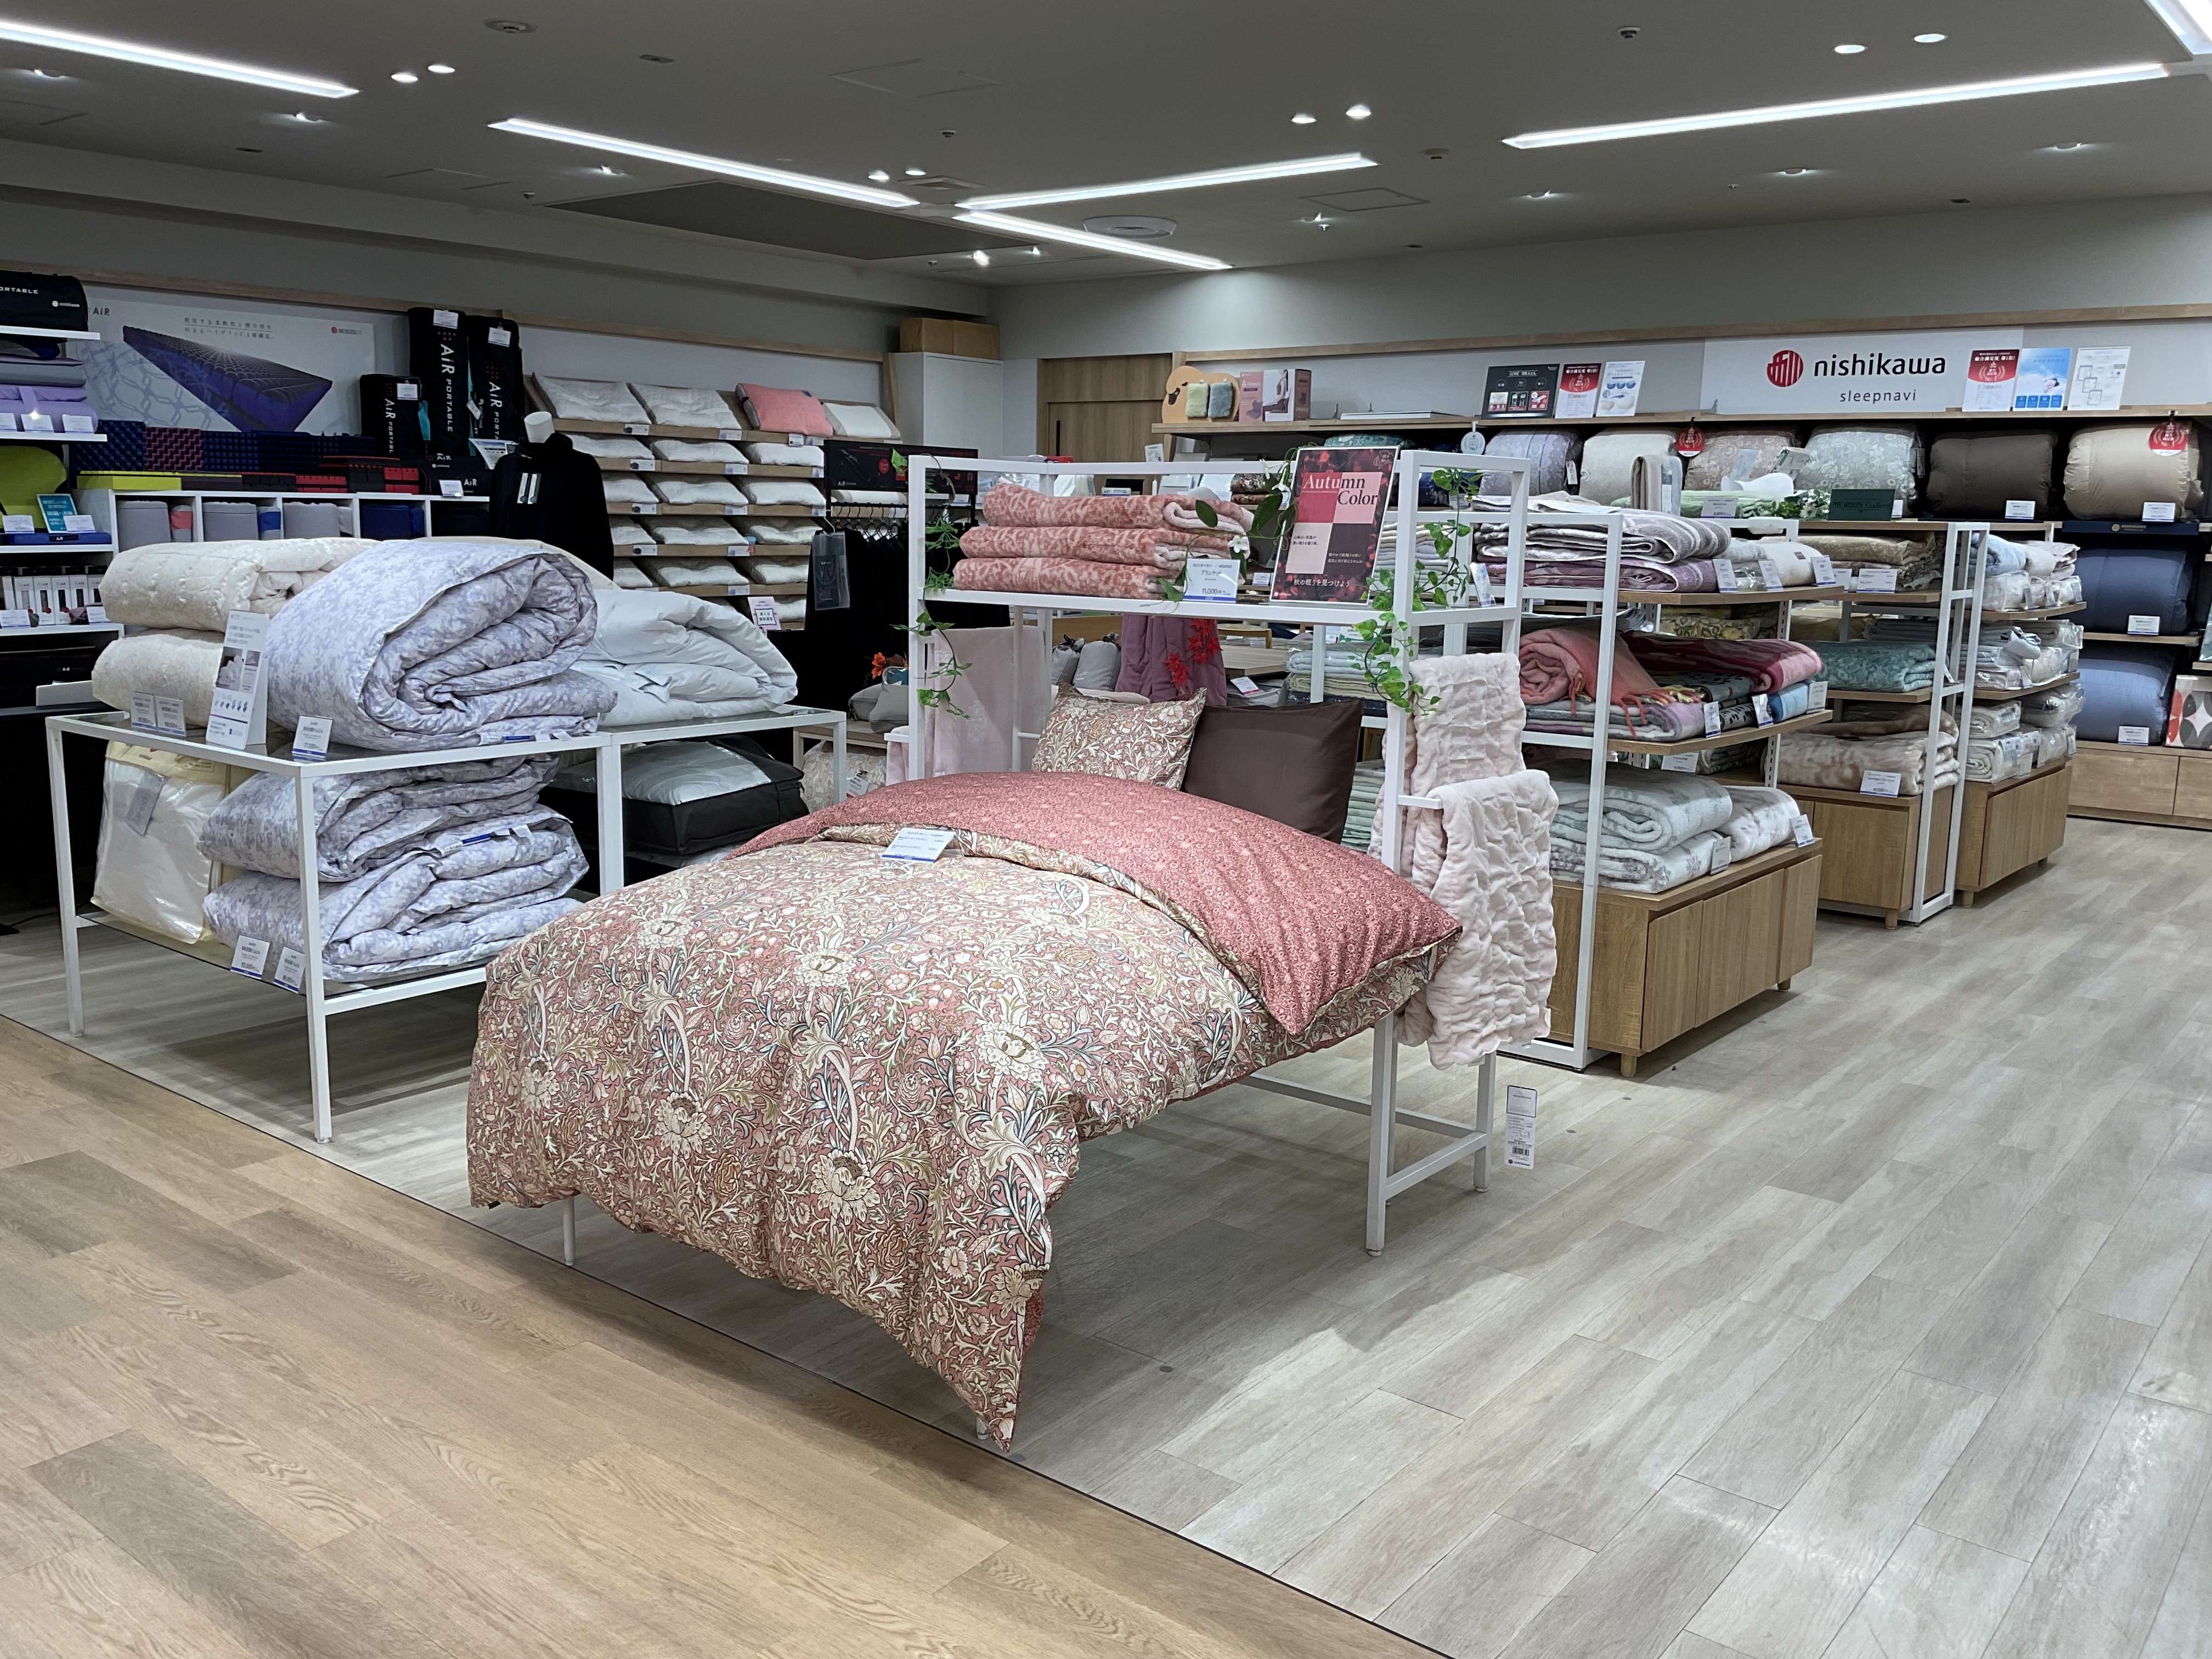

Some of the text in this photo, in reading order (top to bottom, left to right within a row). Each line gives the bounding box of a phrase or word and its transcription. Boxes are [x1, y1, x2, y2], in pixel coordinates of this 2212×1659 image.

[92, 307, 110, 316] AIR
[1814, 353, 1946, 377] nishikawa
[1839, 390, 1916, 404] sleepnavi
[1303, 474, 1365, 489] Autumn
[1338, 490, 1378, 505] Color
[1294, 579, 1350, 587] 秋の眠りを見つけよう
